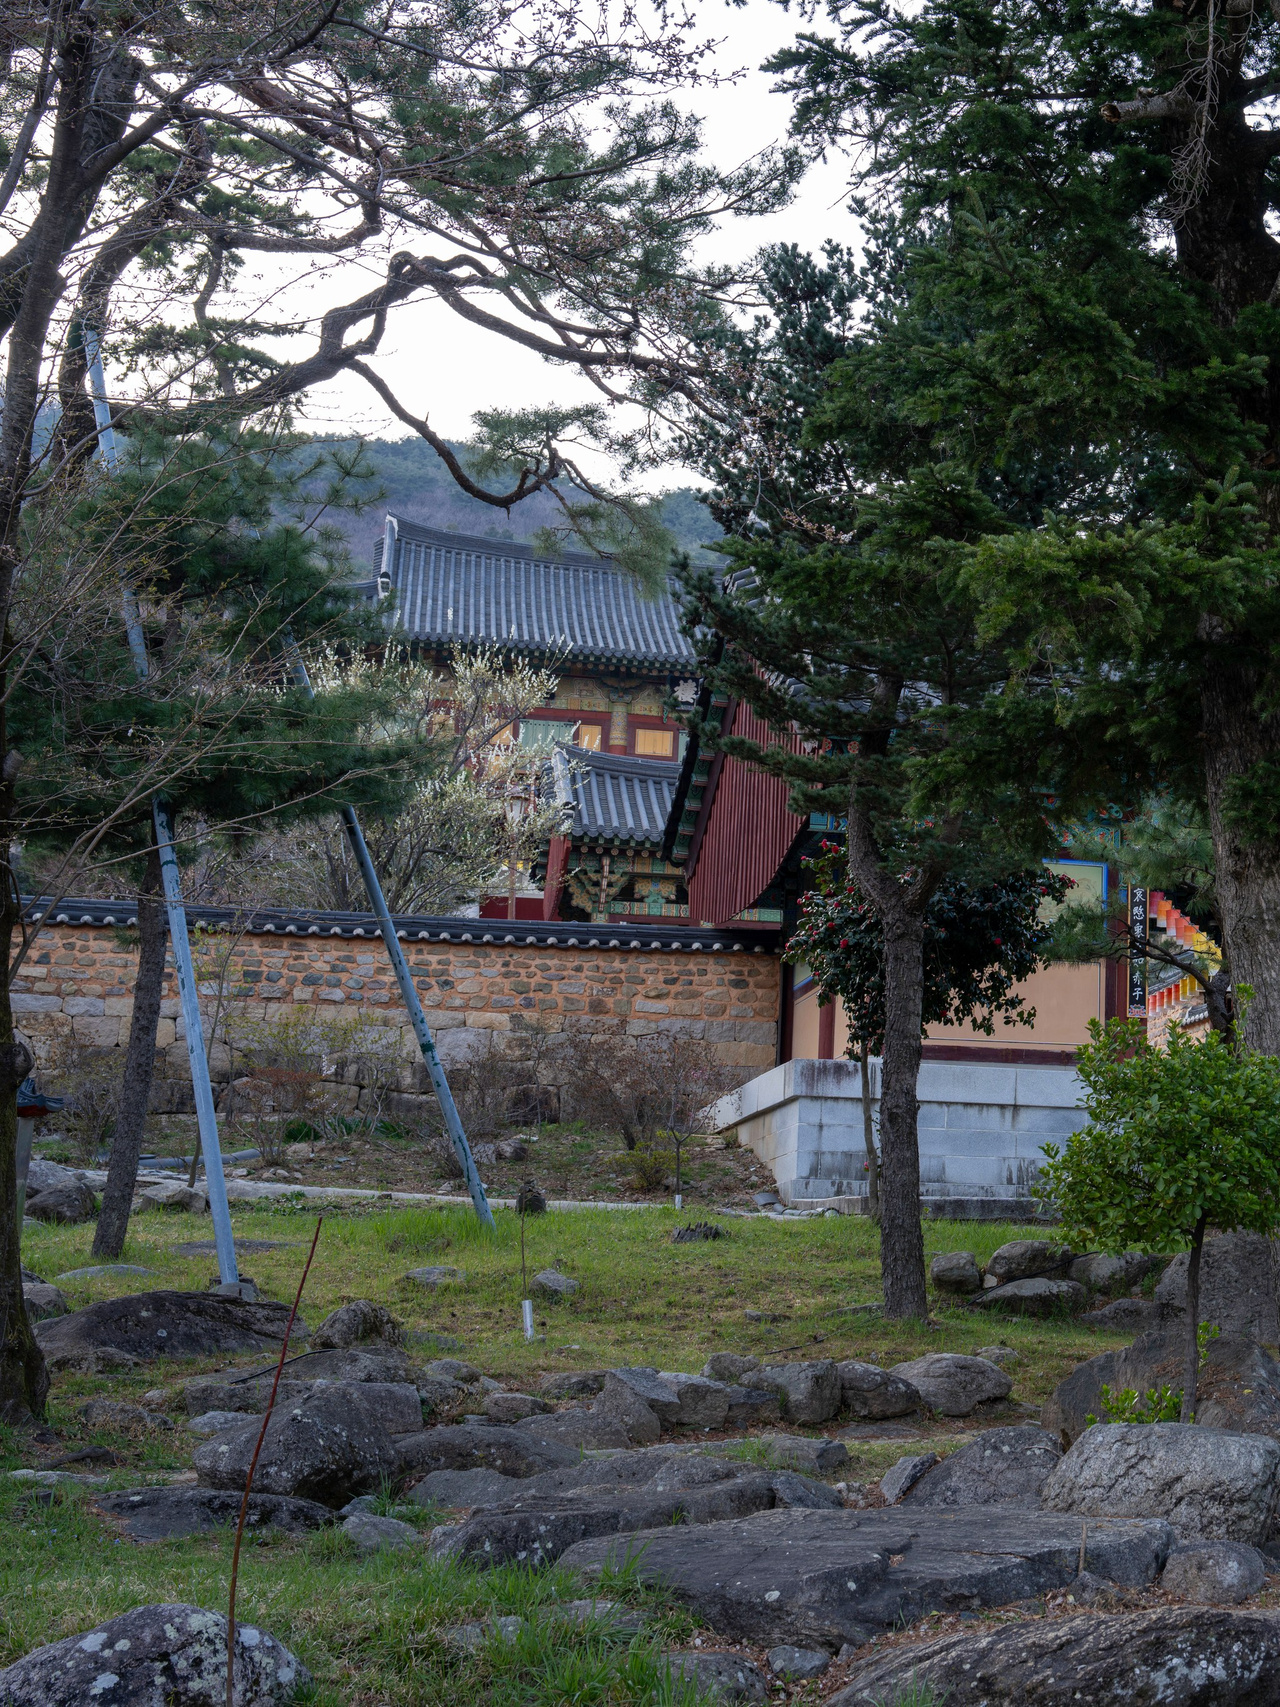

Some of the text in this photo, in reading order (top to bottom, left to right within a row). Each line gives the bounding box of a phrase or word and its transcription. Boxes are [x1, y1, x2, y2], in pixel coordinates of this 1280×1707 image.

[1132, 887, 1146, 1001] 哀愍衆如赤子
